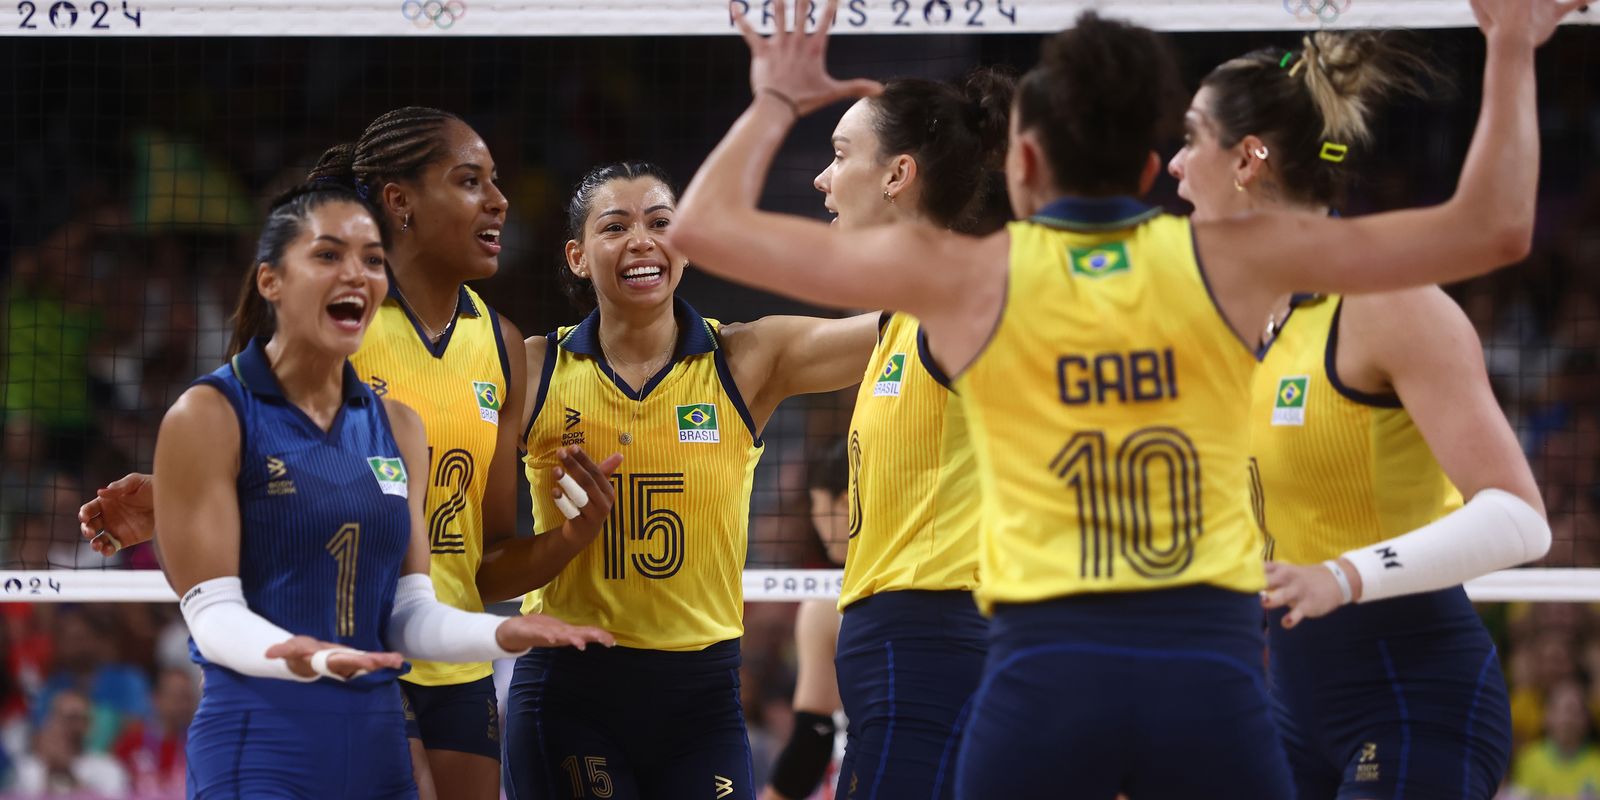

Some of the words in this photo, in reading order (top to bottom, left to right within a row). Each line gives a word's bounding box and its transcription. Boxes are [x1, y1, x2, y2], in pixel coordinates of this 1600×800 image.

[1056, 347, 1179, 405] GABI
[561, 438, 585, 447] WORK
[562, 431, 584, 440] BODY
[679, 430, 719, 442] BRASIL
[603, 473, 685, 580] 15
[1048, 426, 1204, 580] 10
[325, 523, 361, 637] 1
[560, 755, 614, 799] 15
